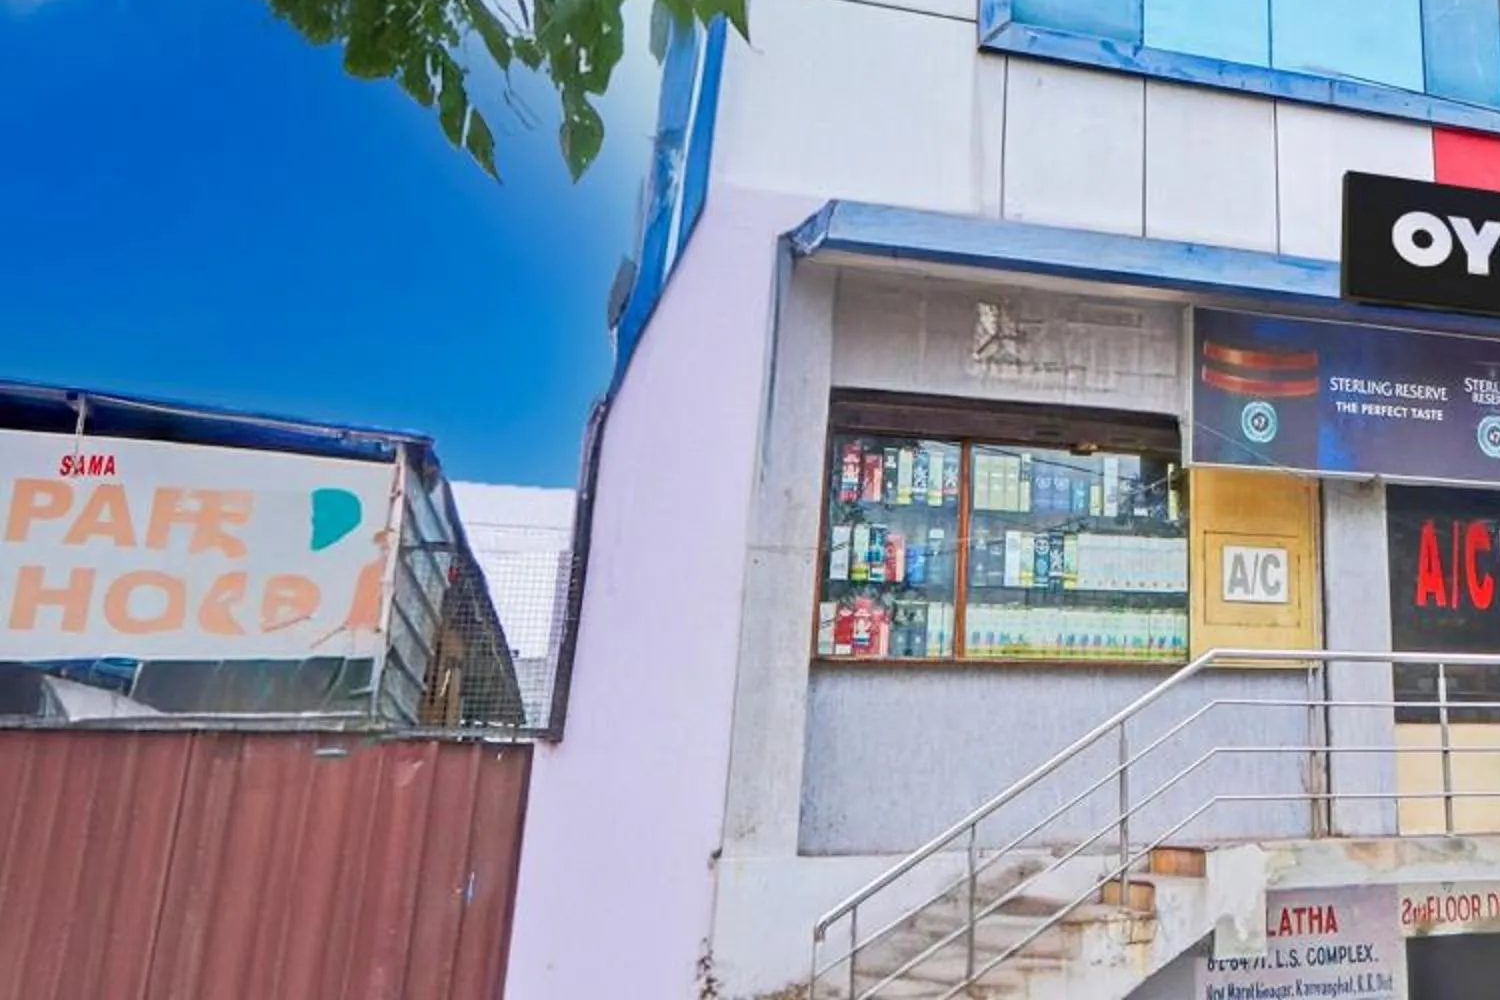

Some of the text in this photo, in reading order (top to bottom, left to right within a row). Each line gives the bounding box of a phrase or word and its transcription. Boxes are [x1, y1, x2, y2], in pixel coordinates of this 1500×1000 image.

[1330, 377, 1449, 401] STERLING RESERVE
[1336, 401, 1444, 421] THE PERFECT TASTE
[60, 455, 117, 477] SAMA
[1227, 552, 1283, 596] A/C
[1416, 518, 1495, 610] A/C
[1426, 893, 1482, 923] FLOOR
